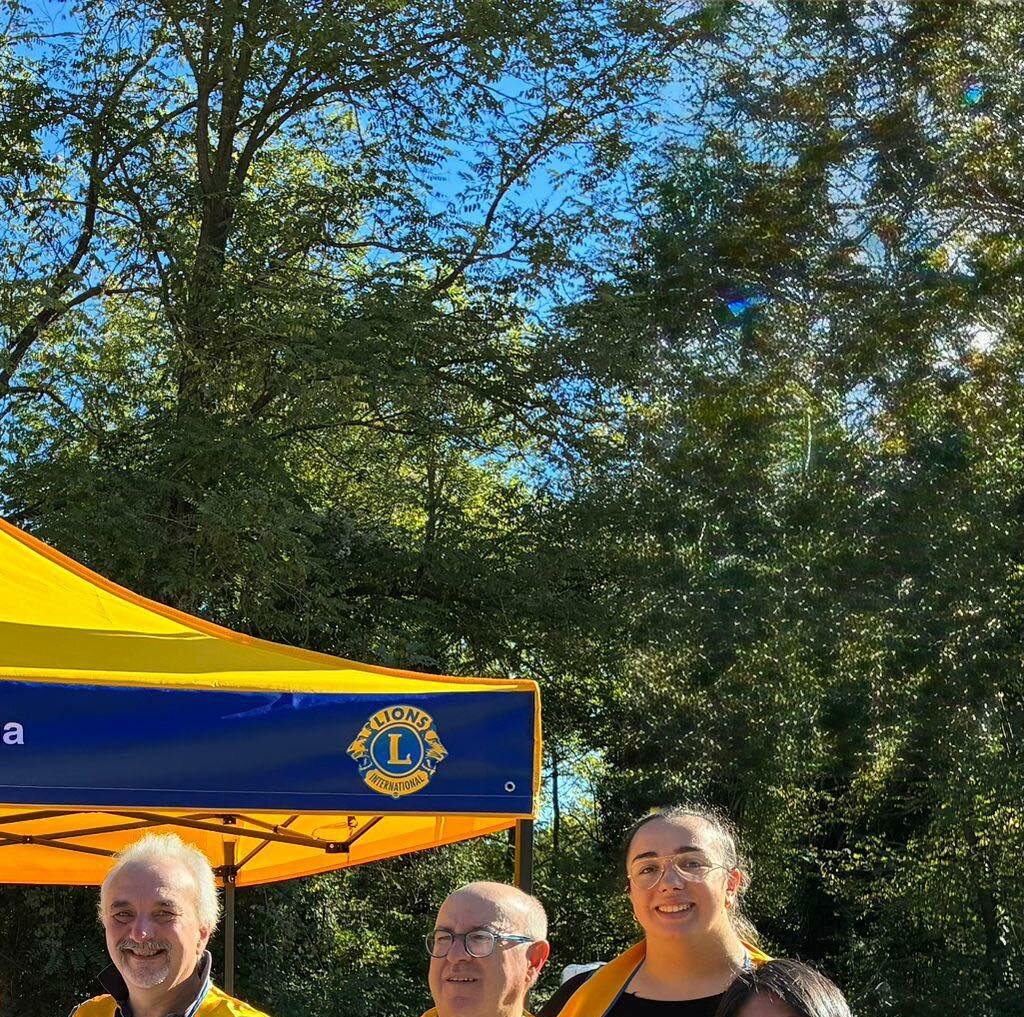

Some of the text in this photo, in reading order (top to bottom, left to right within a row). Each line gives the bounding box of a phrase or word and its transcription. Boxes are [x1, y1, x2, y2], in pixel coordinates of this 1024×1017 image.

[373, 707, 429, 728] LIONS
[387, 733, 412, 765] L
[368, 773, 426, 792] INTERNATIONAL
